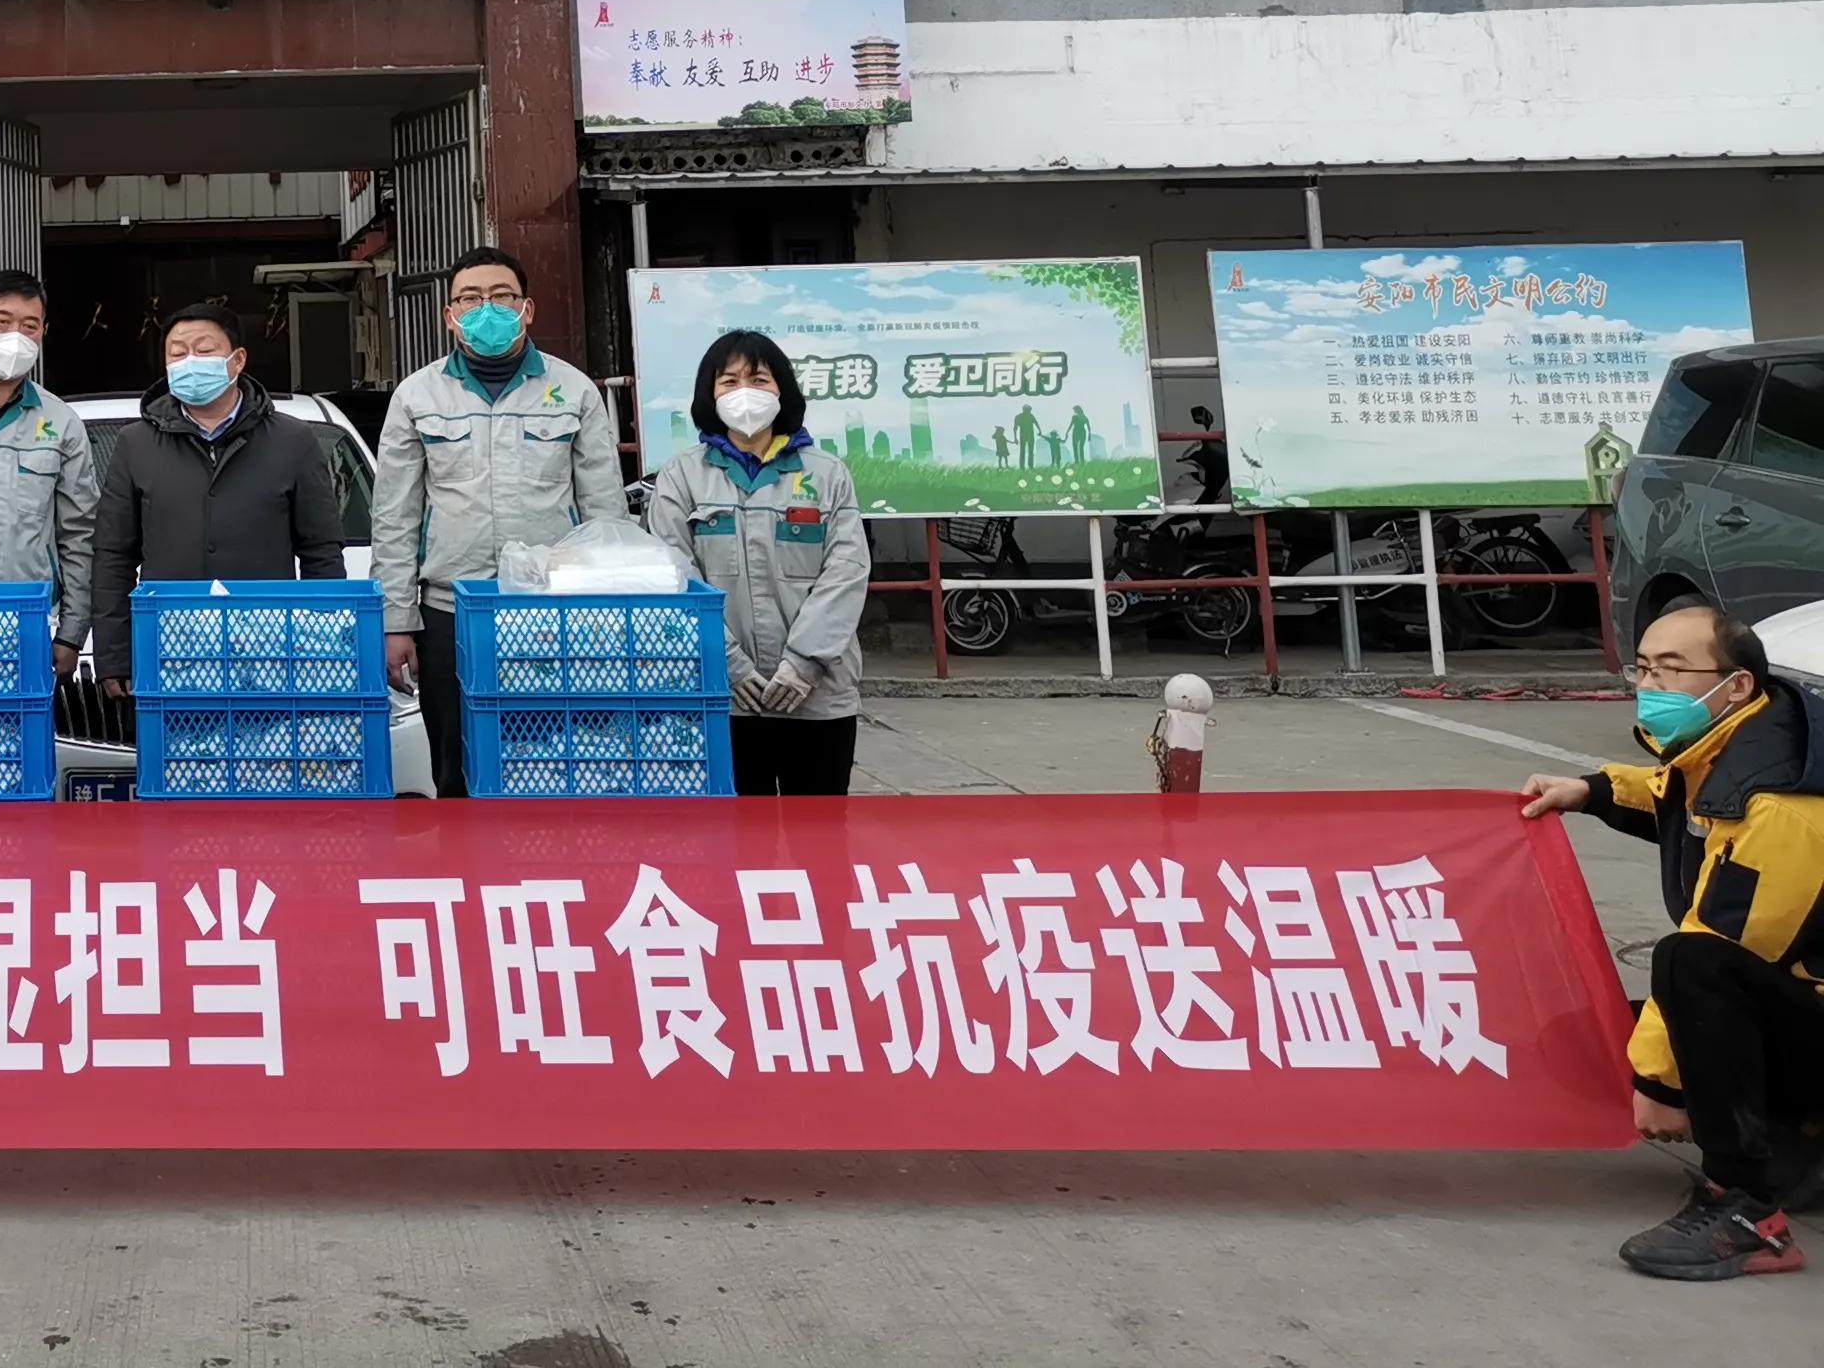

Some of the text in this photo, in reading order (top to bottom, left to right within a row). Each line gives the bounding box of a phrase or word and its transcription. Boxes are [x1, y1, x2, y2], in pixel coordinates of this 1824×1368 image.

[627, 53, 836, 91] 奉献 友爱 互助 进步
[1356, 273, 1607, 320] 安阳市民文明公约
[1414, 334, 1471, 347] 建设安阳
[1590, 331, 1645, 344] 崇尚科学
[1416, 353, 1472, 366] 诚实守信
[1593, 351, 1647, 364] 文明出行
[789, 353, 1065, 397] 有我 爱卫同行
[1418, 372, 1475, 385] 维护秩序
[1595, 370, 1650, 384] 珍惜资源
[1420, 391, 1477, 404] 保护生态
[1422, 409, 1478, 423] 助残济困
[356, 854, 1510, 1081] 可旺食品抗疫送温暖
